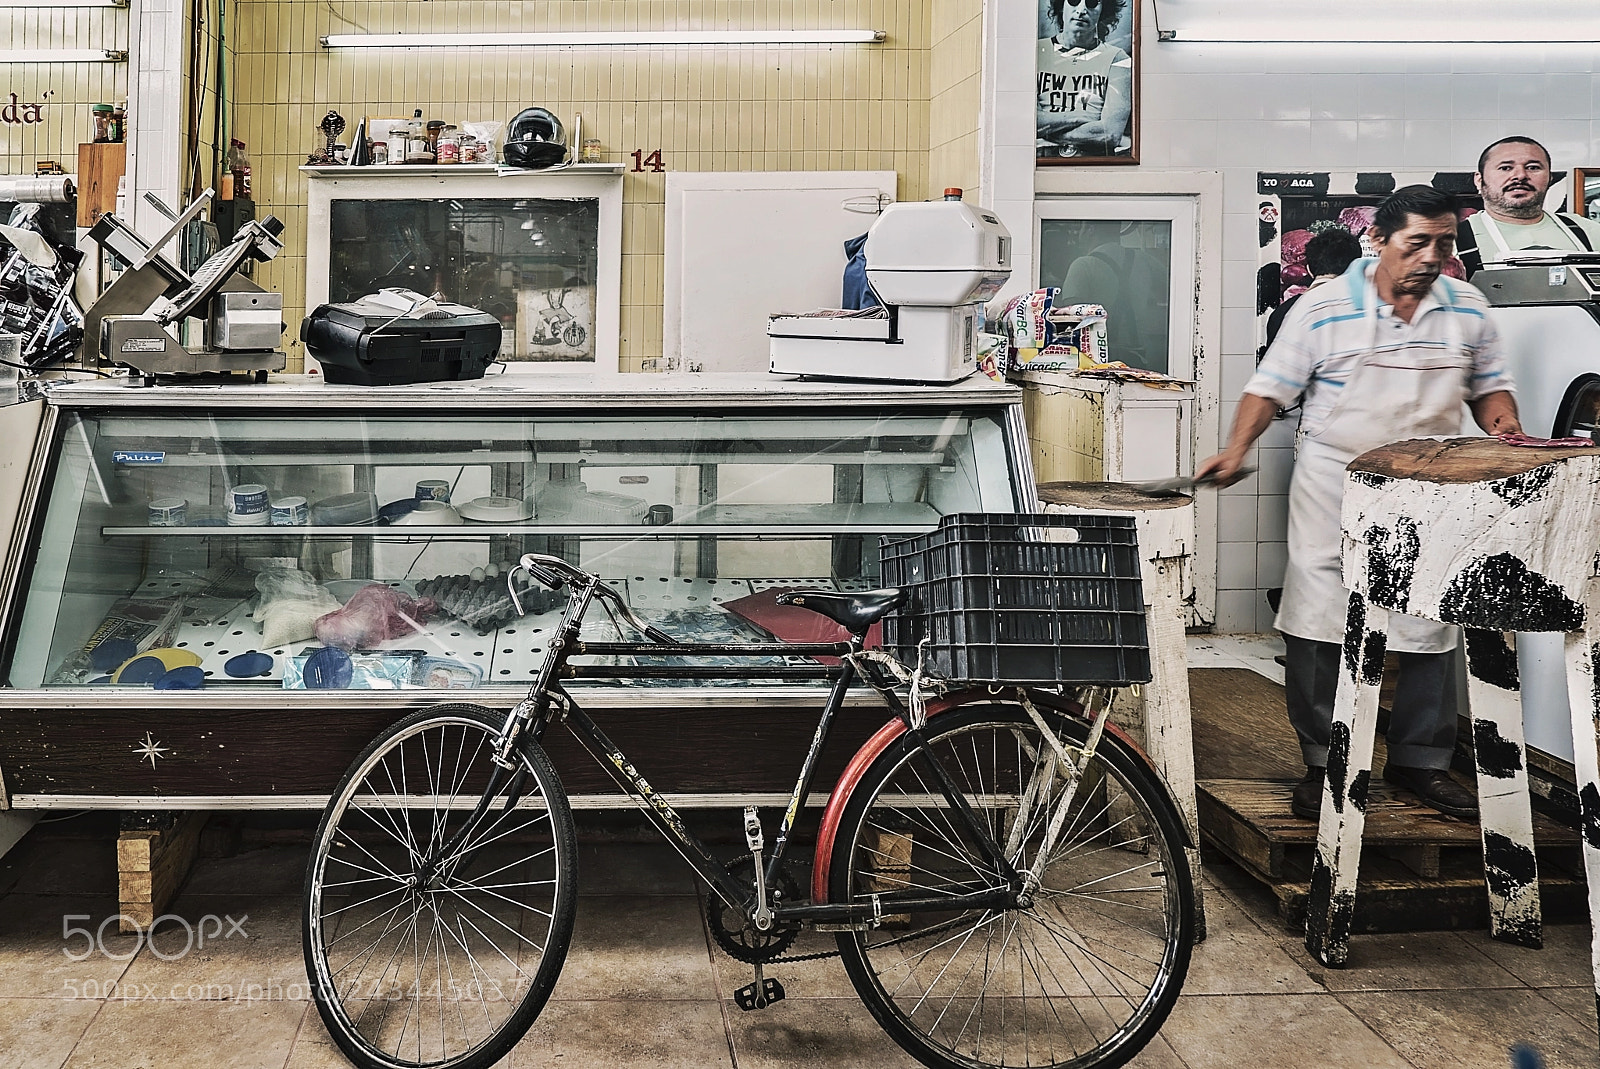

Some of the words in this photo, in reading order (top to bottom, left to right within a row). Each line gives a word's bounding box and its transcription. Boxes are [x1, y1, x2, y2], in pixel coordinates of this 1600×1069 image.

[1049, 91, 1092, 113] CITY
[630, 148, 666, 173] 14
[1262, 178, 1278, 187] YO
